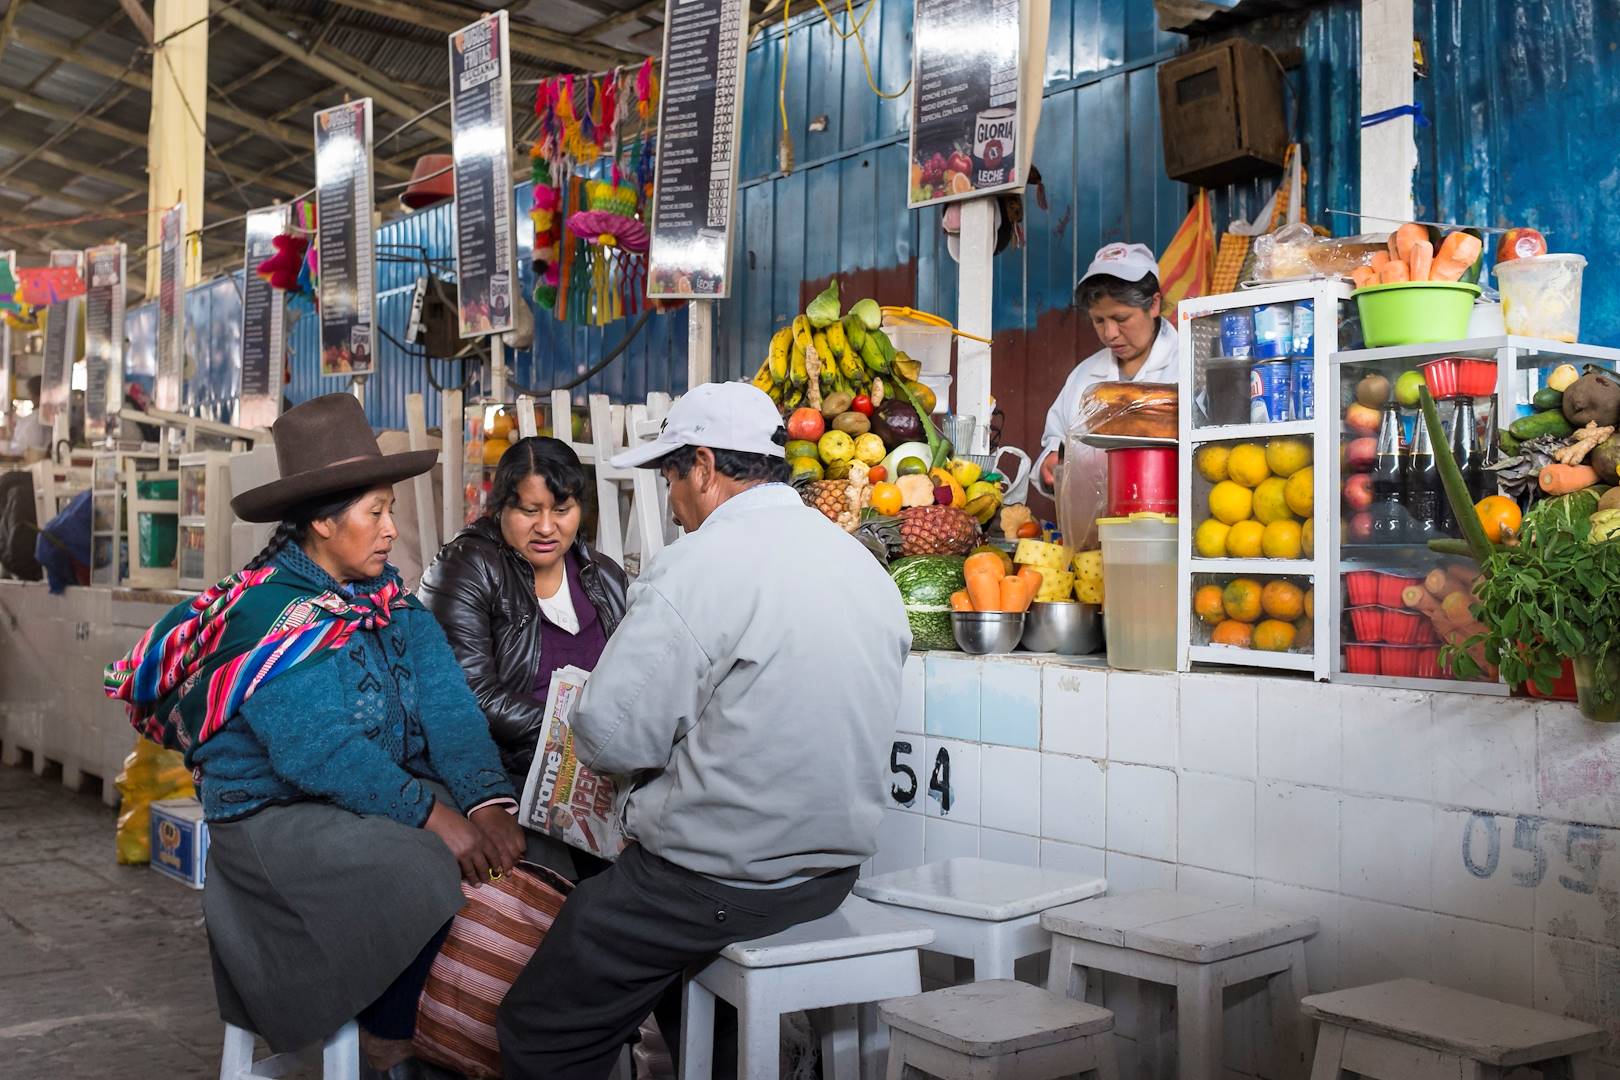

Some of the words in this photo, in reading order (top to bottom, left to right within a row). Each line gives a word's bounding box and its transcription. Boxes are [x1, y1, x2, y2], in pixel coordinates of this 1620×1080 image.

[977, 121, 1013, 143] GLORIA
[978, 168, 1004, 182] LECHE
[531, 752, 562, 823] trome
